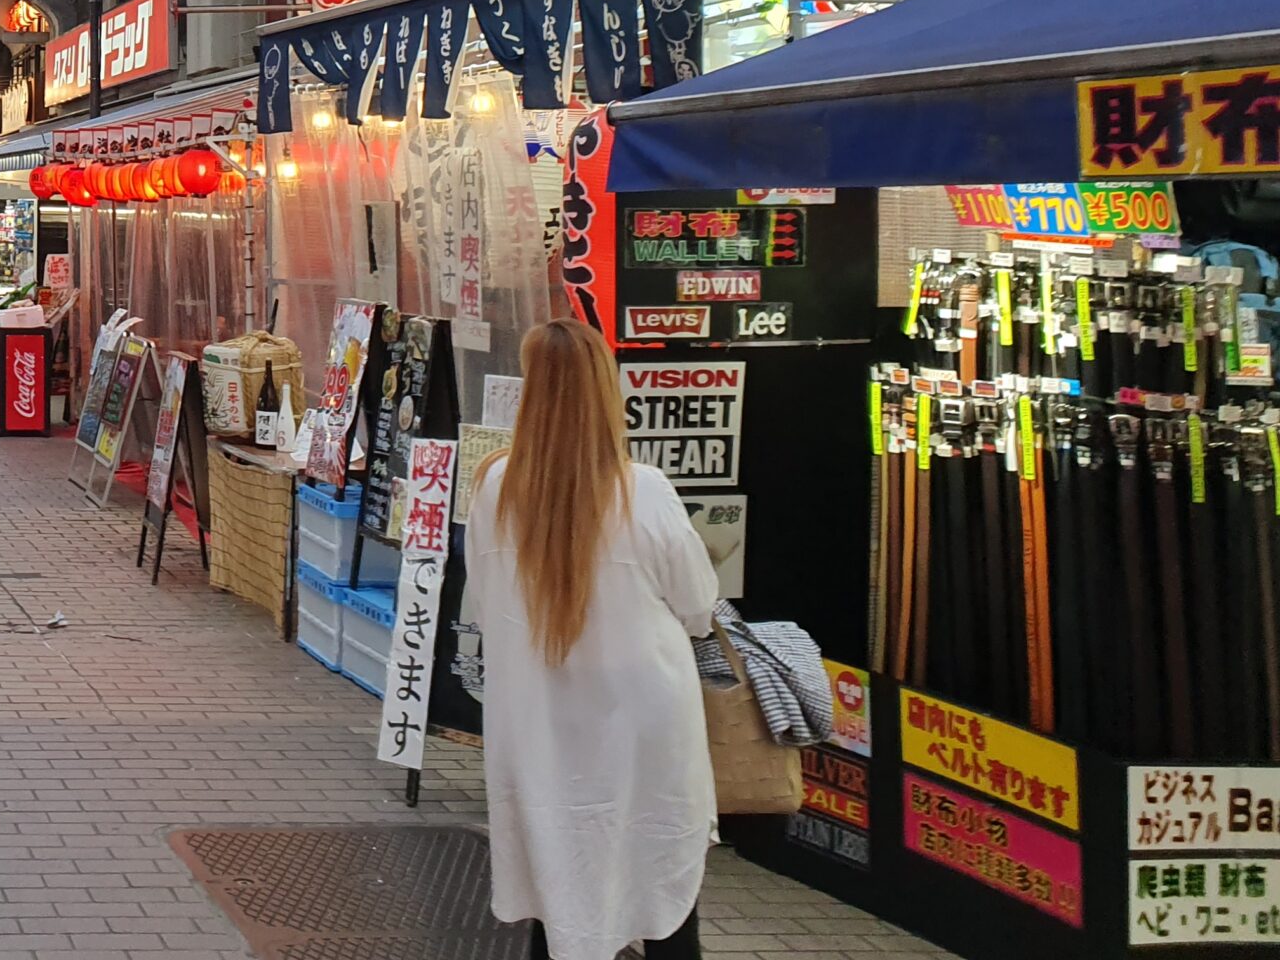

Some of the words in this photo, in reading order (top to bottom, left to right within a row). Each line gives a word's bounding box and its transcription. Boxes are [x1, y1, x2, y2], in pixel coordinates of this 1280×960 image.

[360, 23, 373, 70] もも
[52, 44, 76, 90] クスリ
[633, 211, 740, 238] 財布
[1010, 196, 1084, 233] ¥770
[1082, 190, 1172, 230] ¥500
[460, 152, 482, 318] 店内喫煙
[633, 239, 761, 263] WALLET
[682, 276, 757, 297] EDWIN
[737, 307, 787, 336] Lee
[13, 348, 36, 418] Coca-Cola
[626, 369, 739, 389] VISION
[625, 394, 737, 430] STREET
[630, 438, 726, 476] WEAR
[388, 441, 452, 758] 喫煙できます
[907, 696, 986, 752] 店内にも
[927, 742, 1071, 819] ベルト有ります
[1144, 769, 1217, 805] ビジネス
[1137, 809, 1223, 845] カジュアル
[1228, 787, 1280, 833] Ba
[1217, 862, 1268, 898] 財布
